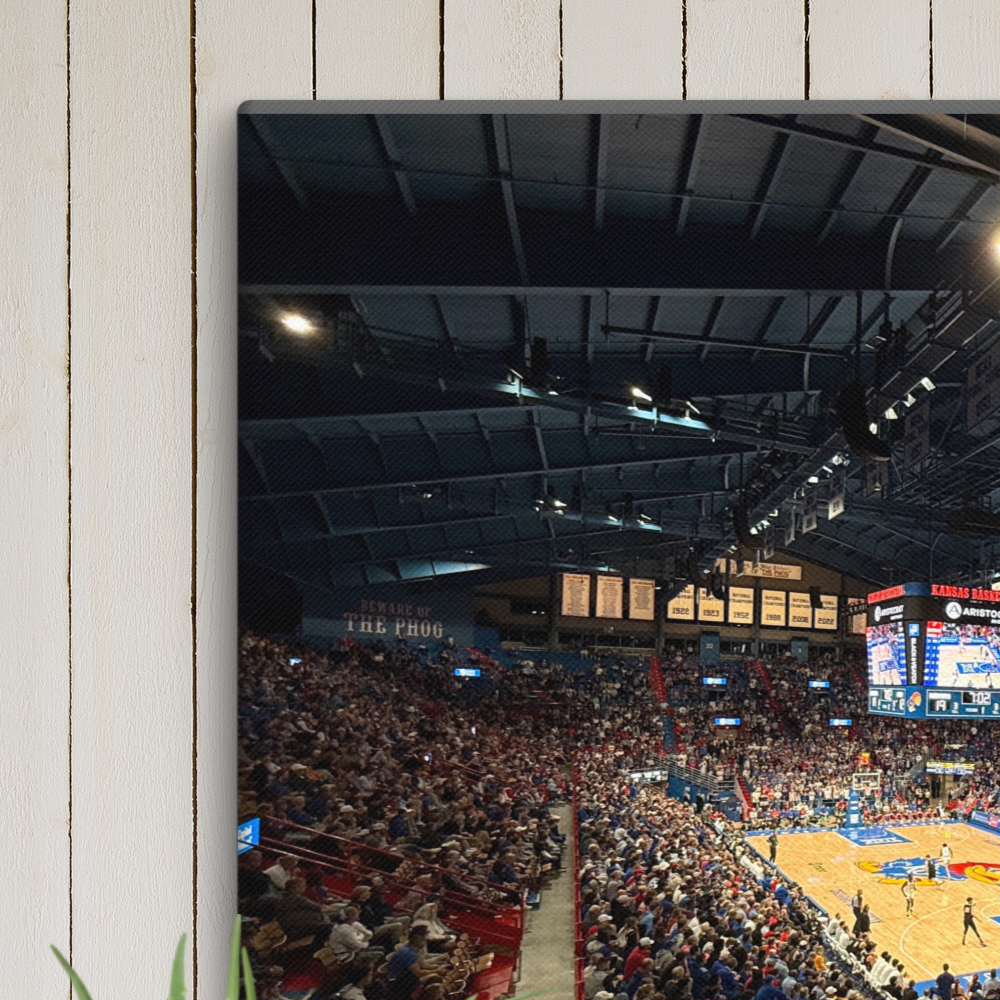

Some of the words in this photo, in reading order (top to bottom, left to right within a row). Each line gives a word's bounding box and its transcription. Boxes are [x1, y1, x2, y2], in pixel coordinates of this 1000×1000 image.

[931, 584, 970, 599] KANSAS
[361, 600, 413, 616] BEWARE
[672, 607, 690, 615] 1922
[703, 609, 720, 617] 1923
[733, 611, 750, 619] 1952
[343, 612, 387, 634] THE
[395, 617, 444, 639] PHOG
[817, 617, 835, 625] 2022
[969, 691, 990, 704] 7:02
